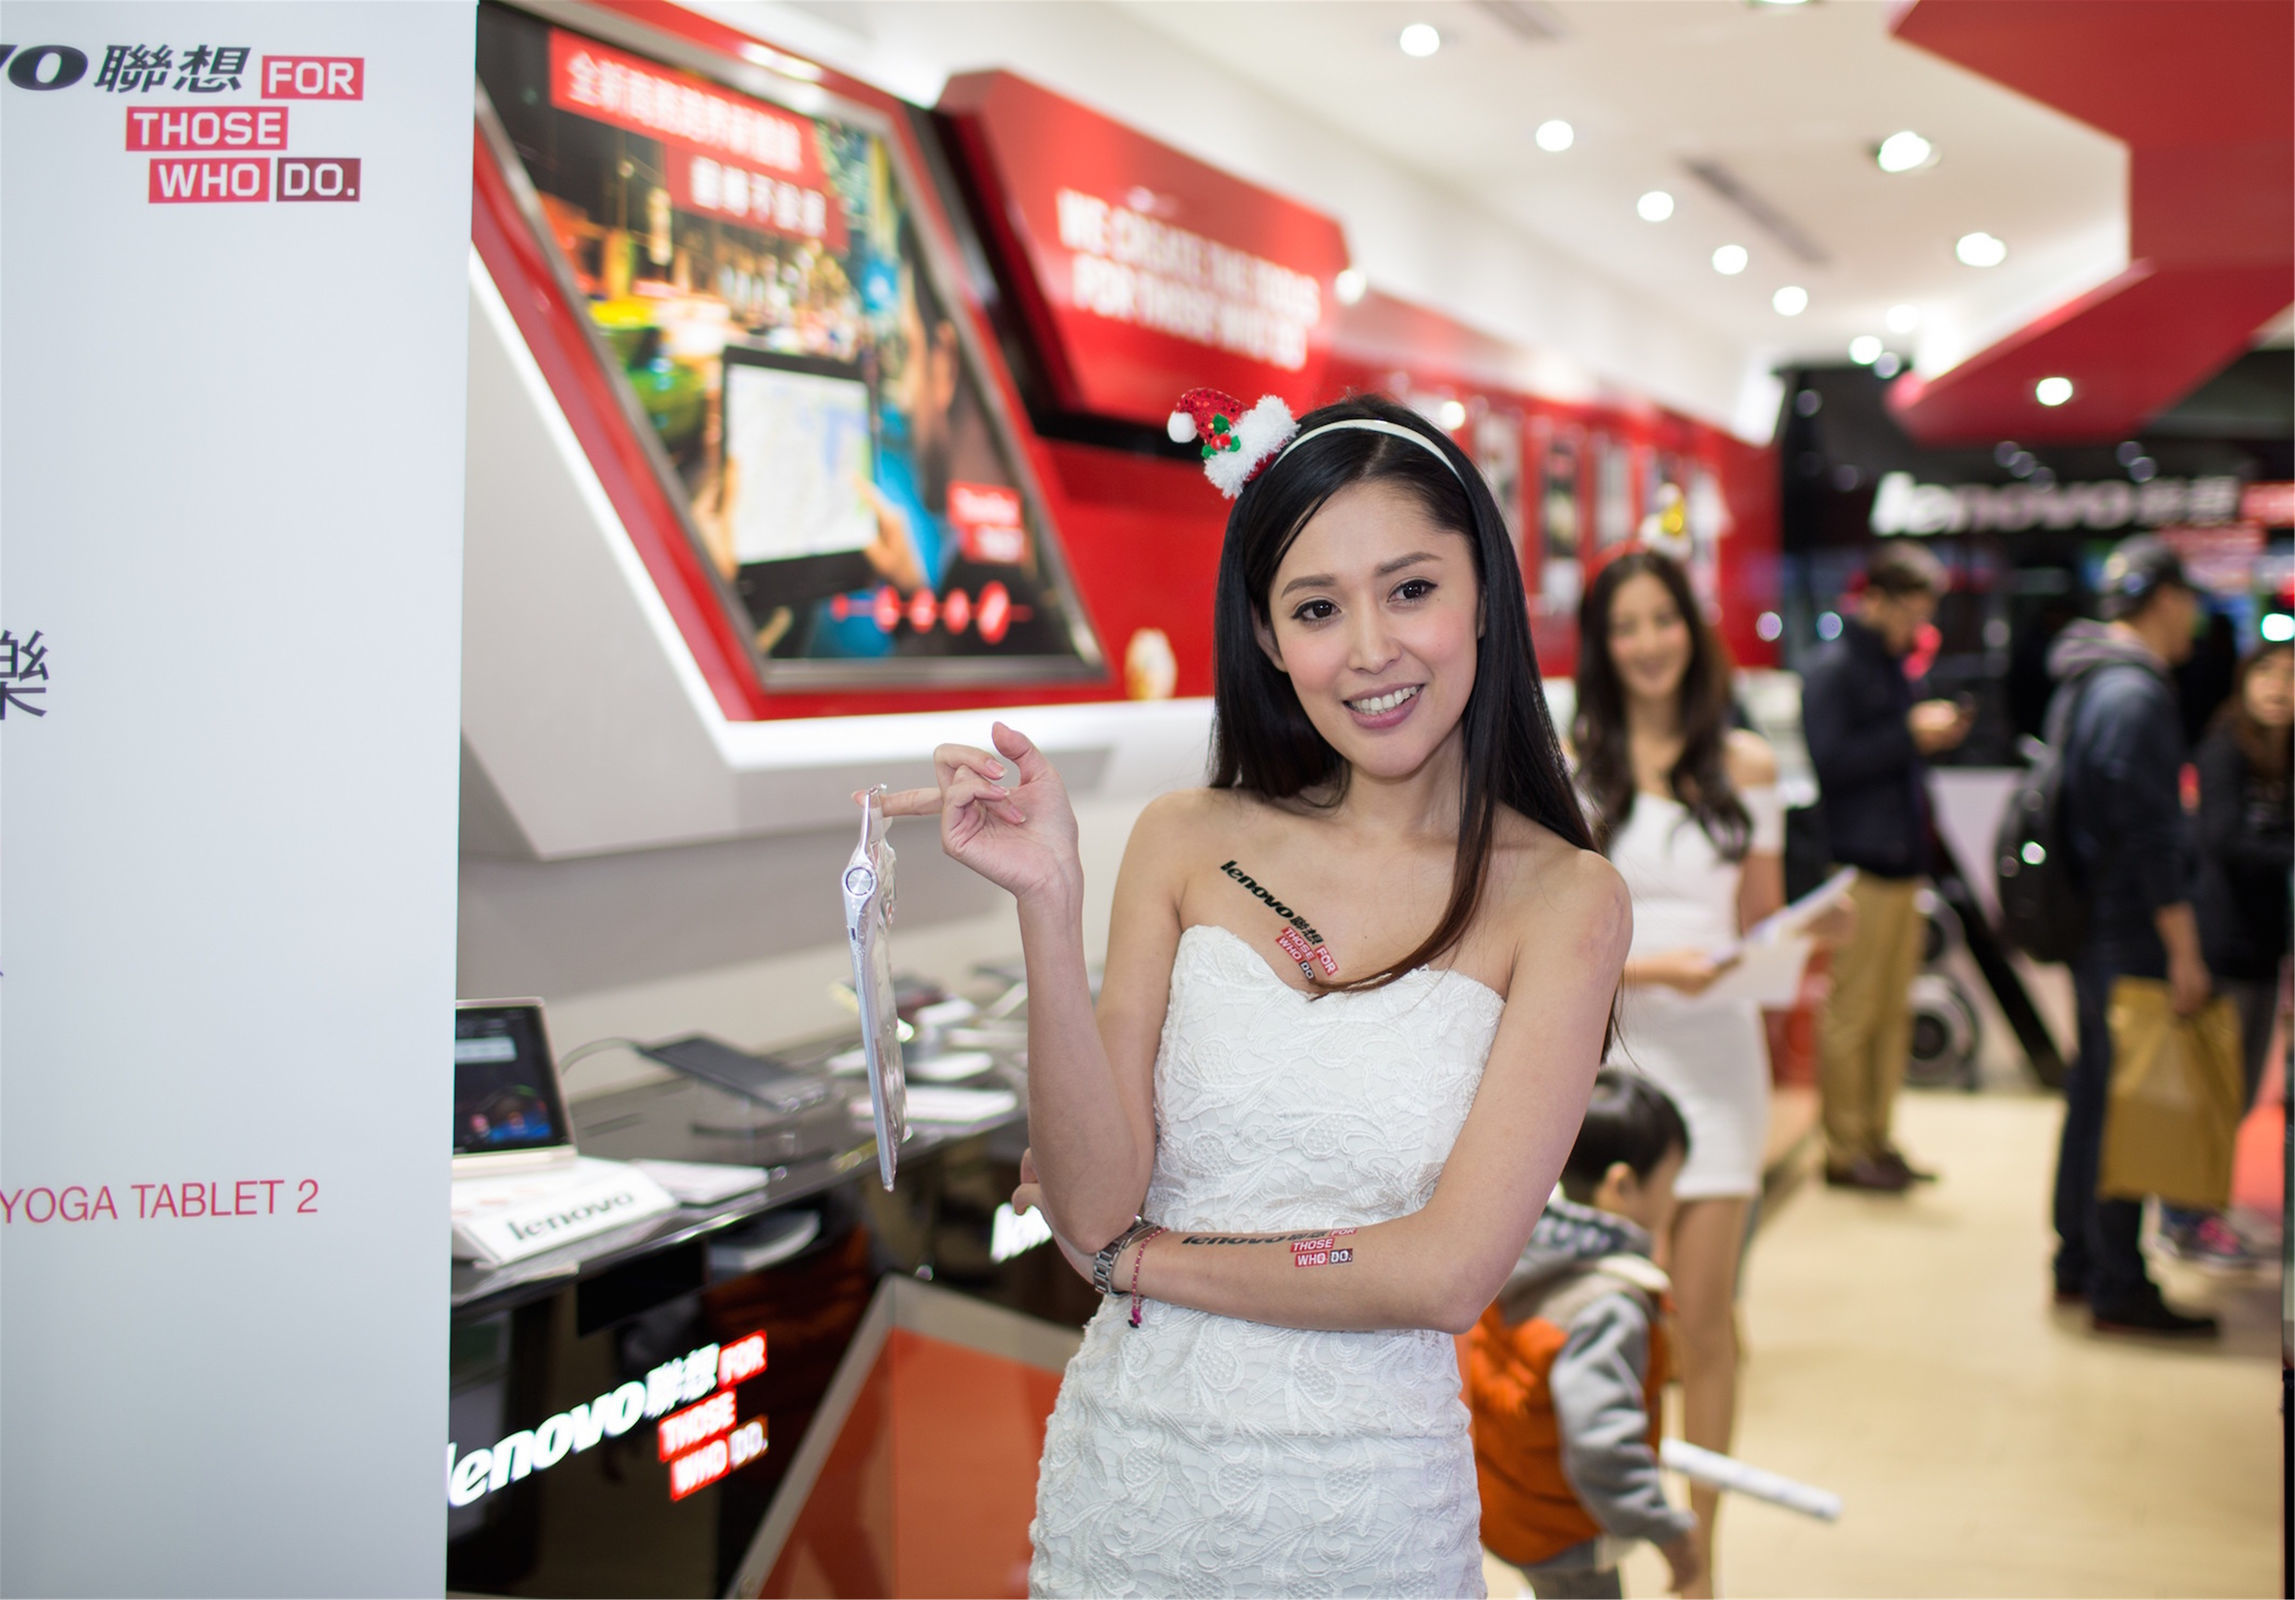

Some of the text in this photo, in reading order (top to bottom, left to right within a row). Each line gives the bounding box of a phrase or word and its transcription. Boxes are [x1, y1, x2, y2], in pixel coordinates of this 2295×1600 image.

[94, 43, 251, 93] 聯想
[268, 61, 355, 95] FOR
[133, 111, 282, 146] THOSE
[158, 163, 356, 197] WHO DO.
[1869, 471, 2134, 536] lenovo
[1220, 859, 1295, 919] lenovo
[1316, 945, 1337, 974] FOR
[1278, 937, 1303, 962] WHO
[1284, 926, 1315, 961] THOSE
[0, 1178, 319, 1224] YOGA TABLET 2
[507, 1192, 635, 1241] lenovo
[1181, 1235, 1286, 1246] lenovo
[1292, 1238, 1333, 1252] THOSE
[1297, 1251, 1326, 1266] WHO
[719, 1334, 766, 1387] FOR
[660, 1389, 736, 1457] THOSE
[673, 1438, 729, 1495] WHO
